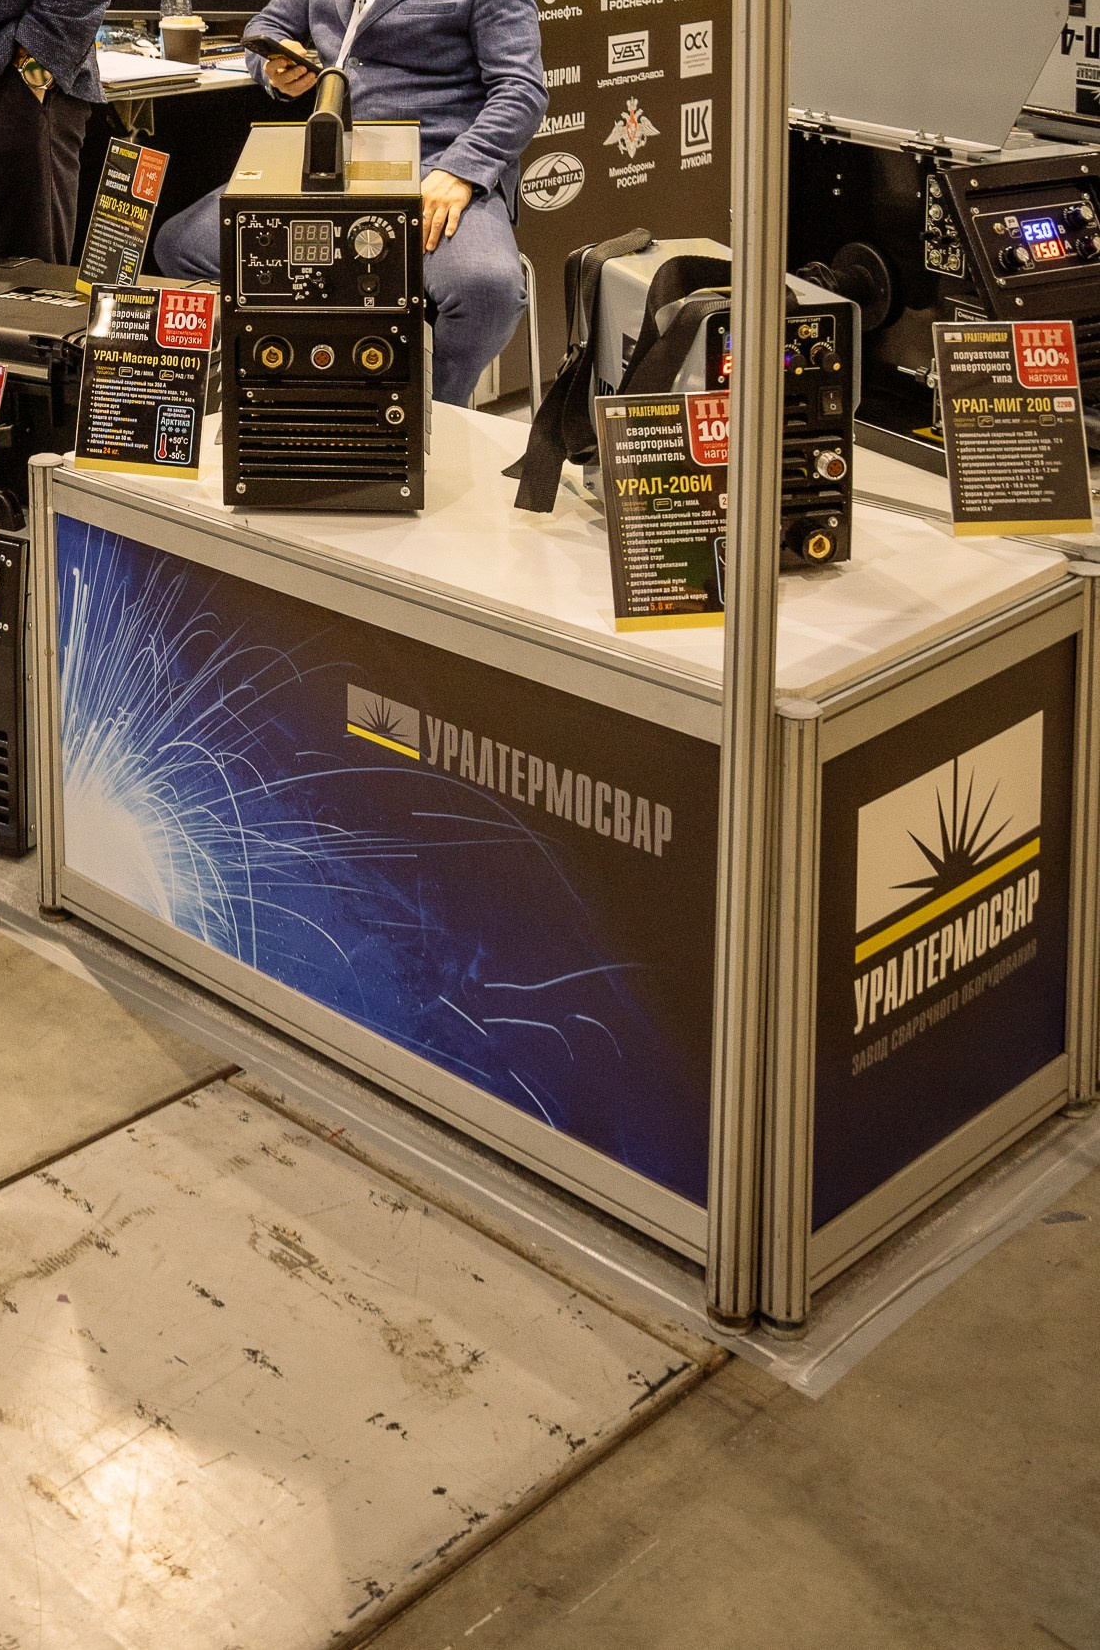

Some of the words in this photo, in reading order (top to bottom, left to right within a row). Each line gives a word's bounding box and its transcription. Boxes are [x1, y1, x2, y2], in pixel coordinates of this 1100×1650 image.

[538, 6, 582, 21] нснефть
[684, 31, 708, 51] ОСК
[543, 66, 580, 88] АЗПРОМ
[537, 112, 585, 135] ЖМАШ
[681, 152, 712, 170] ЛУКОЙЛ
[609, 161, 655, 178] Минобороны
[523, 171, 582, 192] СУРГУТНЕФТЕГАЗ
[617, 173, 647, 188] РОССИИ
[130, 204, 148, 221] УРАЛ
[166, 295, 206, 312] ПН
[112, 310, 150, 320] варочный
[164, 312, 207, 330] 100%
[107, 331, 148, 341] прямитель
[166, 335, 202, 345] нагрузки
[1021, 329, 1064, 346] ПН
[93, 350, 158, 366] УРАЛ-Мастер
[161, 355, 178, 366] 300
[181, 357, 200, 370] (01)
[954, 352, 1009, 361] полуавтомат
[1023, 348, 1069, 366] 100%
[951, 364, 1011, 372] инверторного
[992, 376, 1012, 384] типа
[1028, 374, 1068, 384] нагрузки
[628, 405, 680, 418] УРАЛТЕРМОСВАР
[952, 398, 1023, 414] УРАЛ-МИГ
[1026, 398, 1051, 412] 200
[161, 417, 190, 427] Арктика
[626, 423, 682, 437] сварочный
[698, 421, 729, 442] 10
[616, 437, 684, 451] инверторный
[615, 452, 685, 465] выпрямитель
[704, 449, 728, 459] нагр
[616, 474, 712, 496] УРАЛ-206И
[426, 714, 673, 857] УРАЛТЕРМОСВАР
[854, 869, 1040, 1035] УРАЛТЕРМОСВАР
